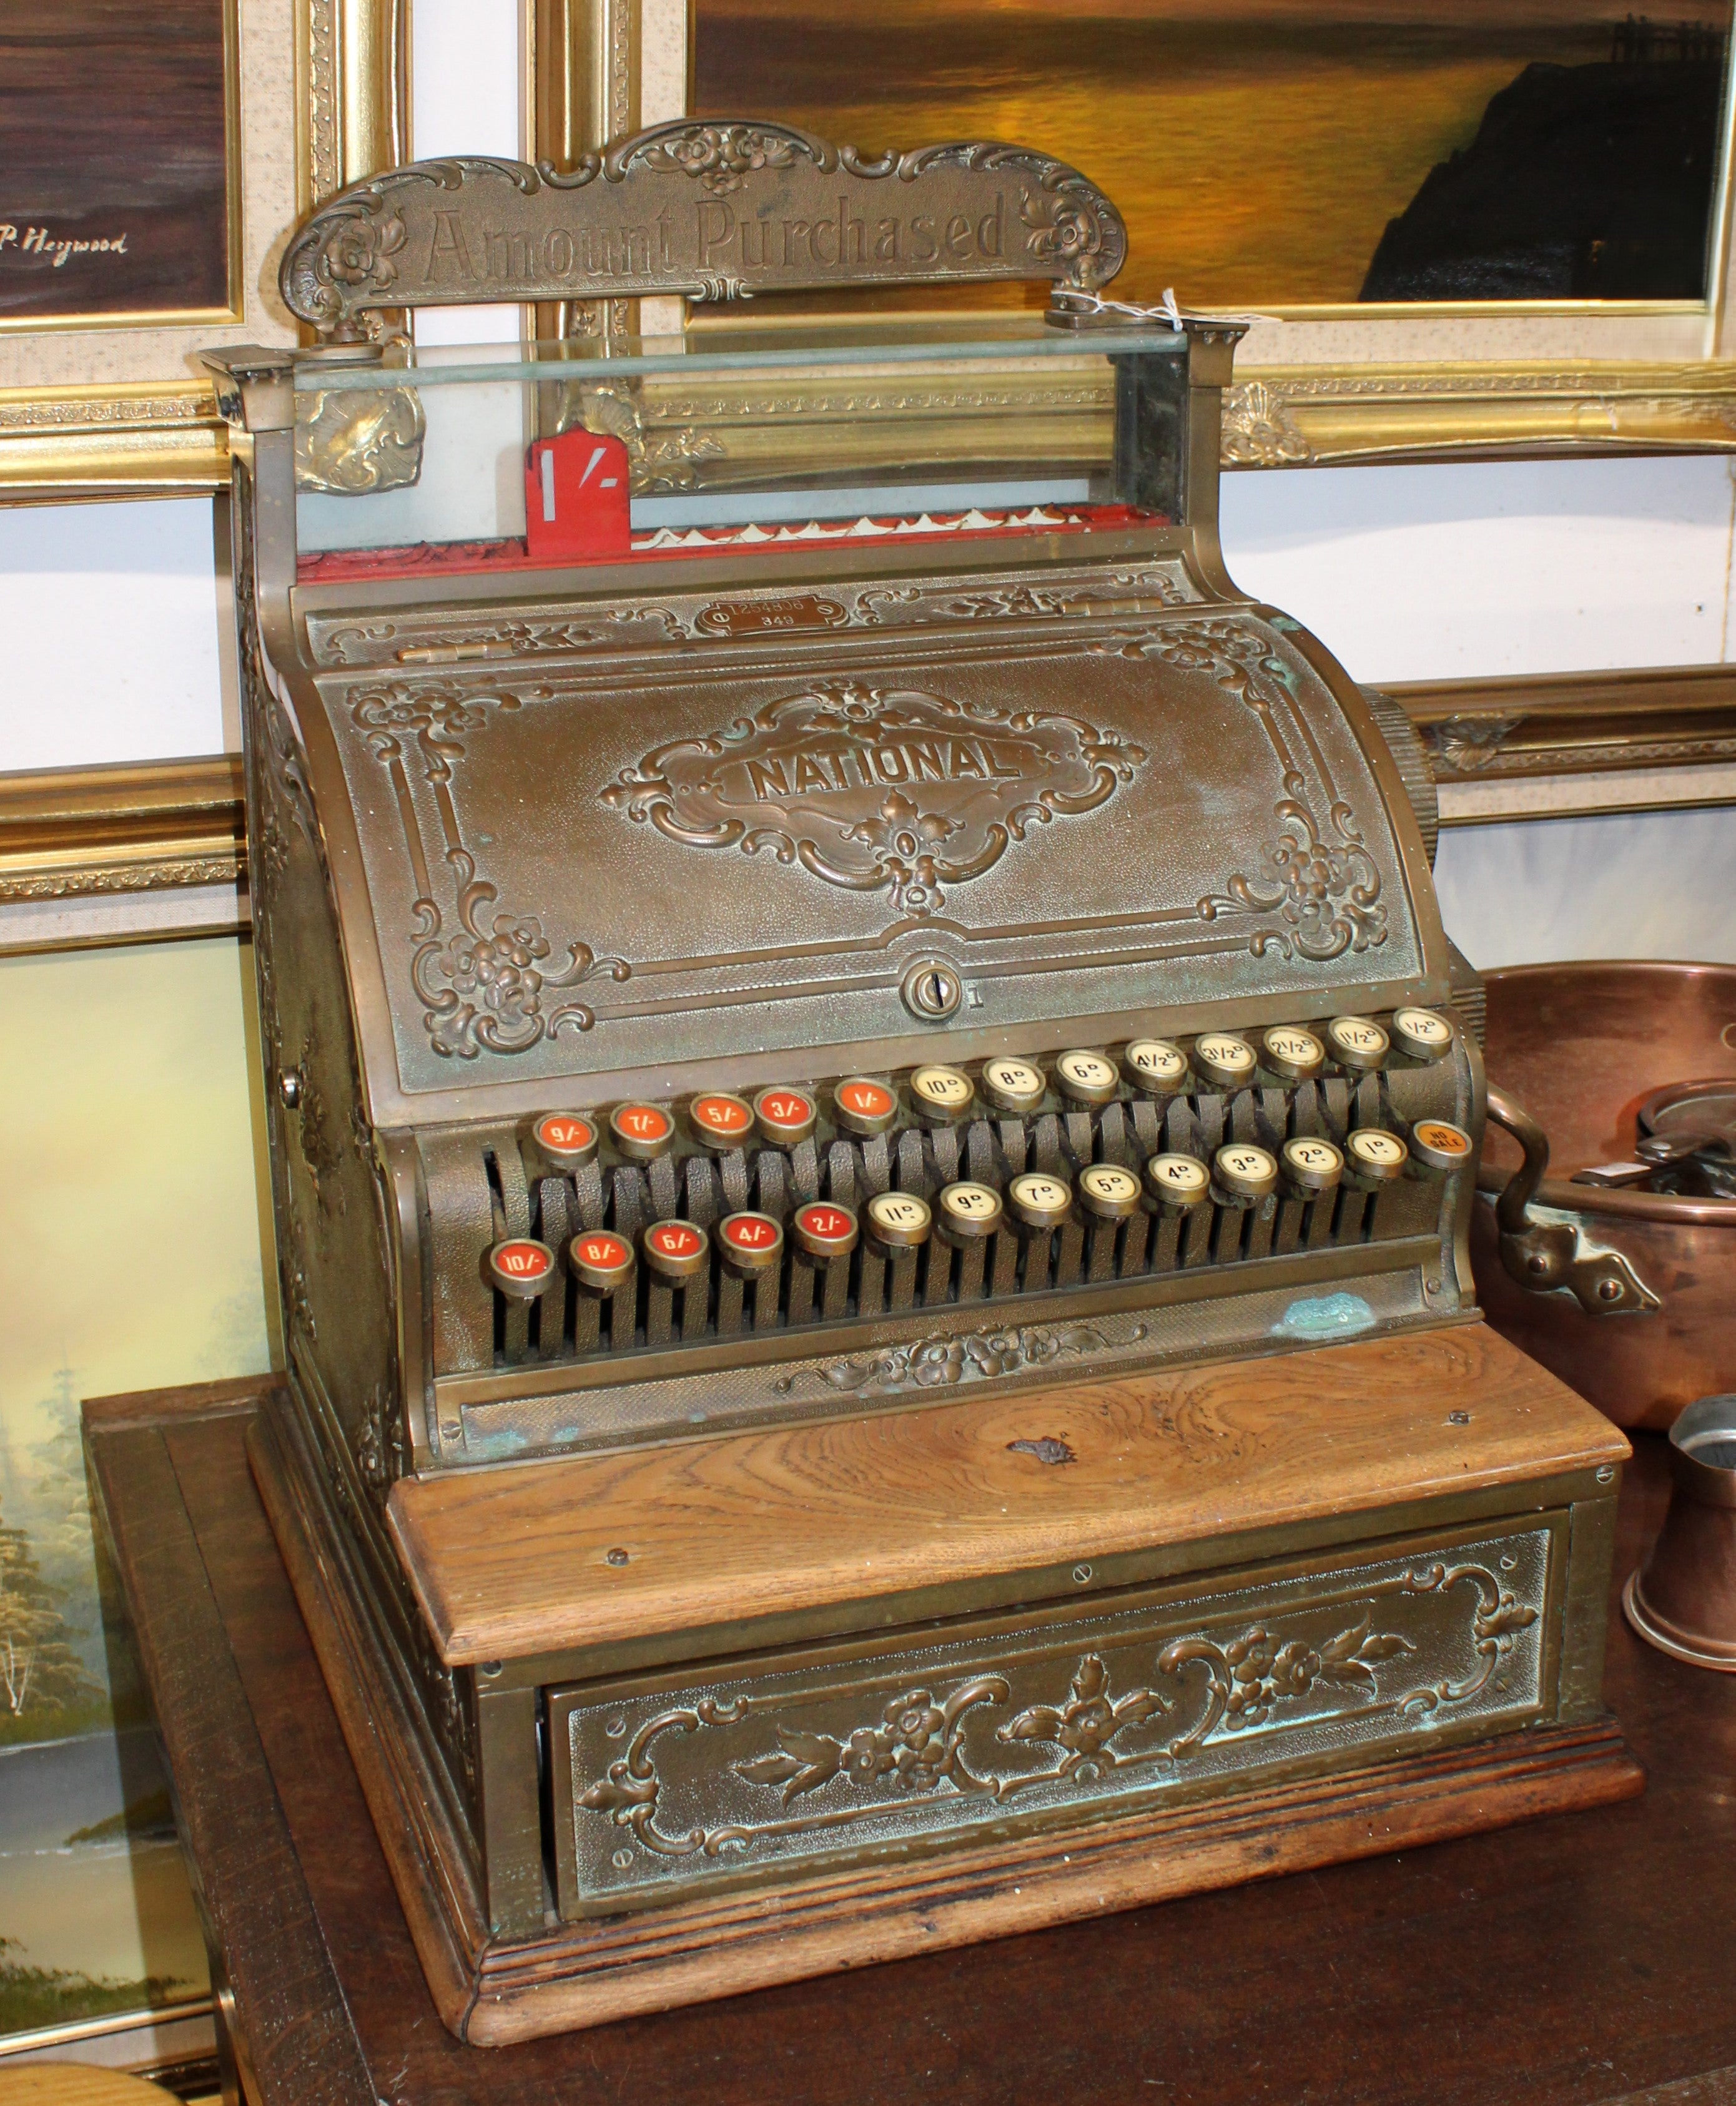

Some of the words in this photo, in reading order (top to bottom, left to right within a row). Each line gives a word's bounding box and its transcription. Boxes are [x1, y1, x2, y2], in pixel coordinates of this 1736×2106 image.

[423, 208, 681, 284] Amount
[694, 192, 1005, 272] Purchased
[745, 741, 1022, 802] NATIONAL
[1430, 1139, 1462, 1148] SALE
